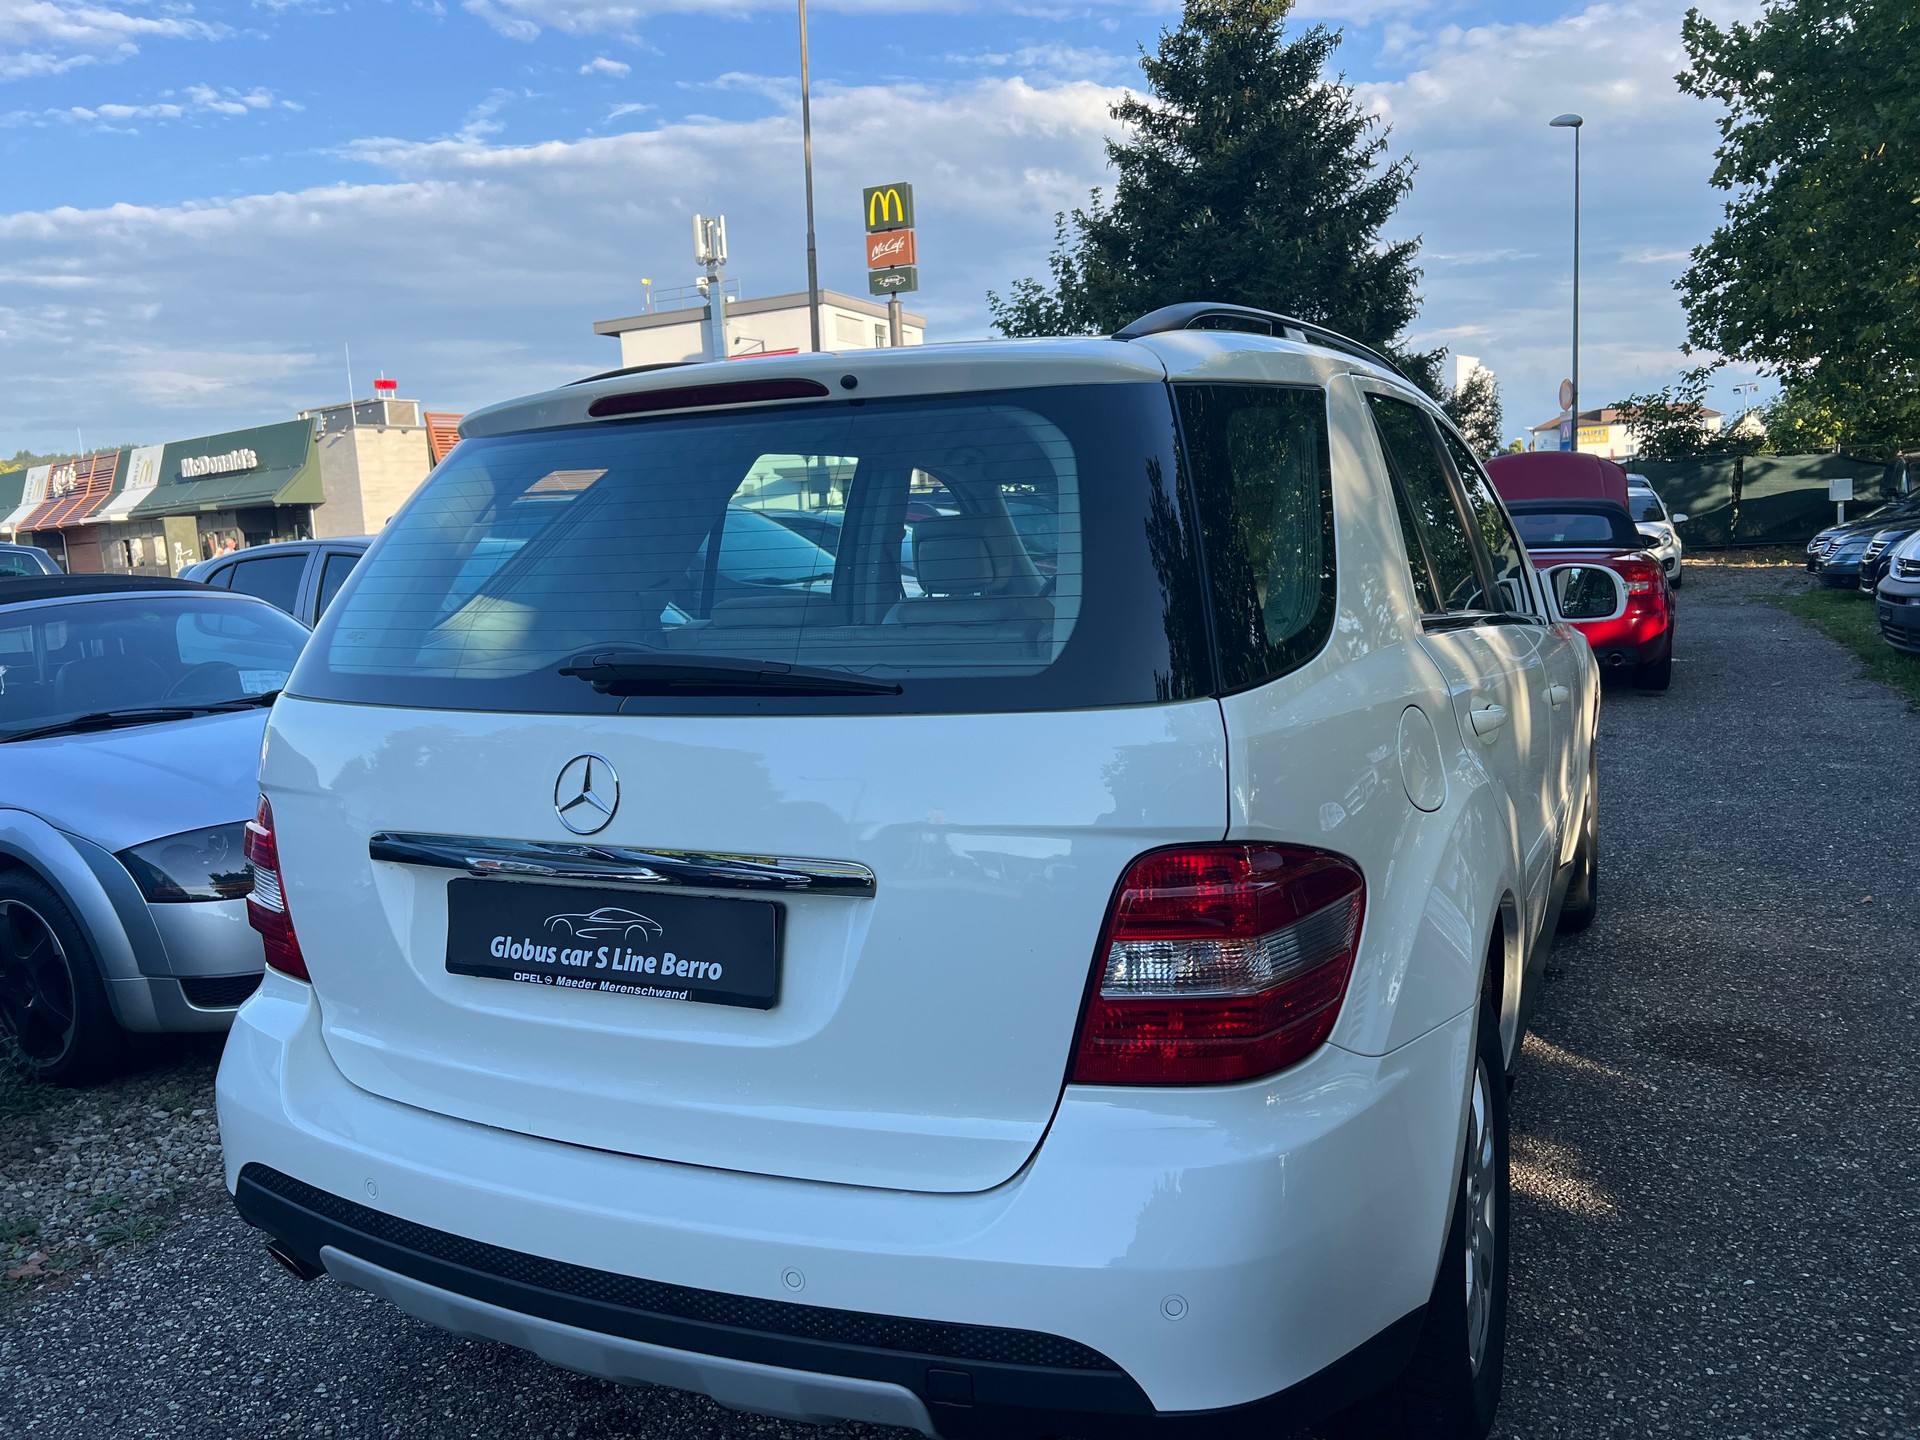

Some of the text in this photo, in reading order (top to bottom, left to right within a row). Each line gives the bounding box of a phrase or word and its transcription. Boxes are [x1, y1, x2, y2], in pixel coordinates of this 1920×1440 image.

[180, 448, 258, 478] McDonald's
[490, 936, 723, 981] Globus car S Line Berro
[513, 971, 688, 1001] OPEL Maeder Merenschwand
